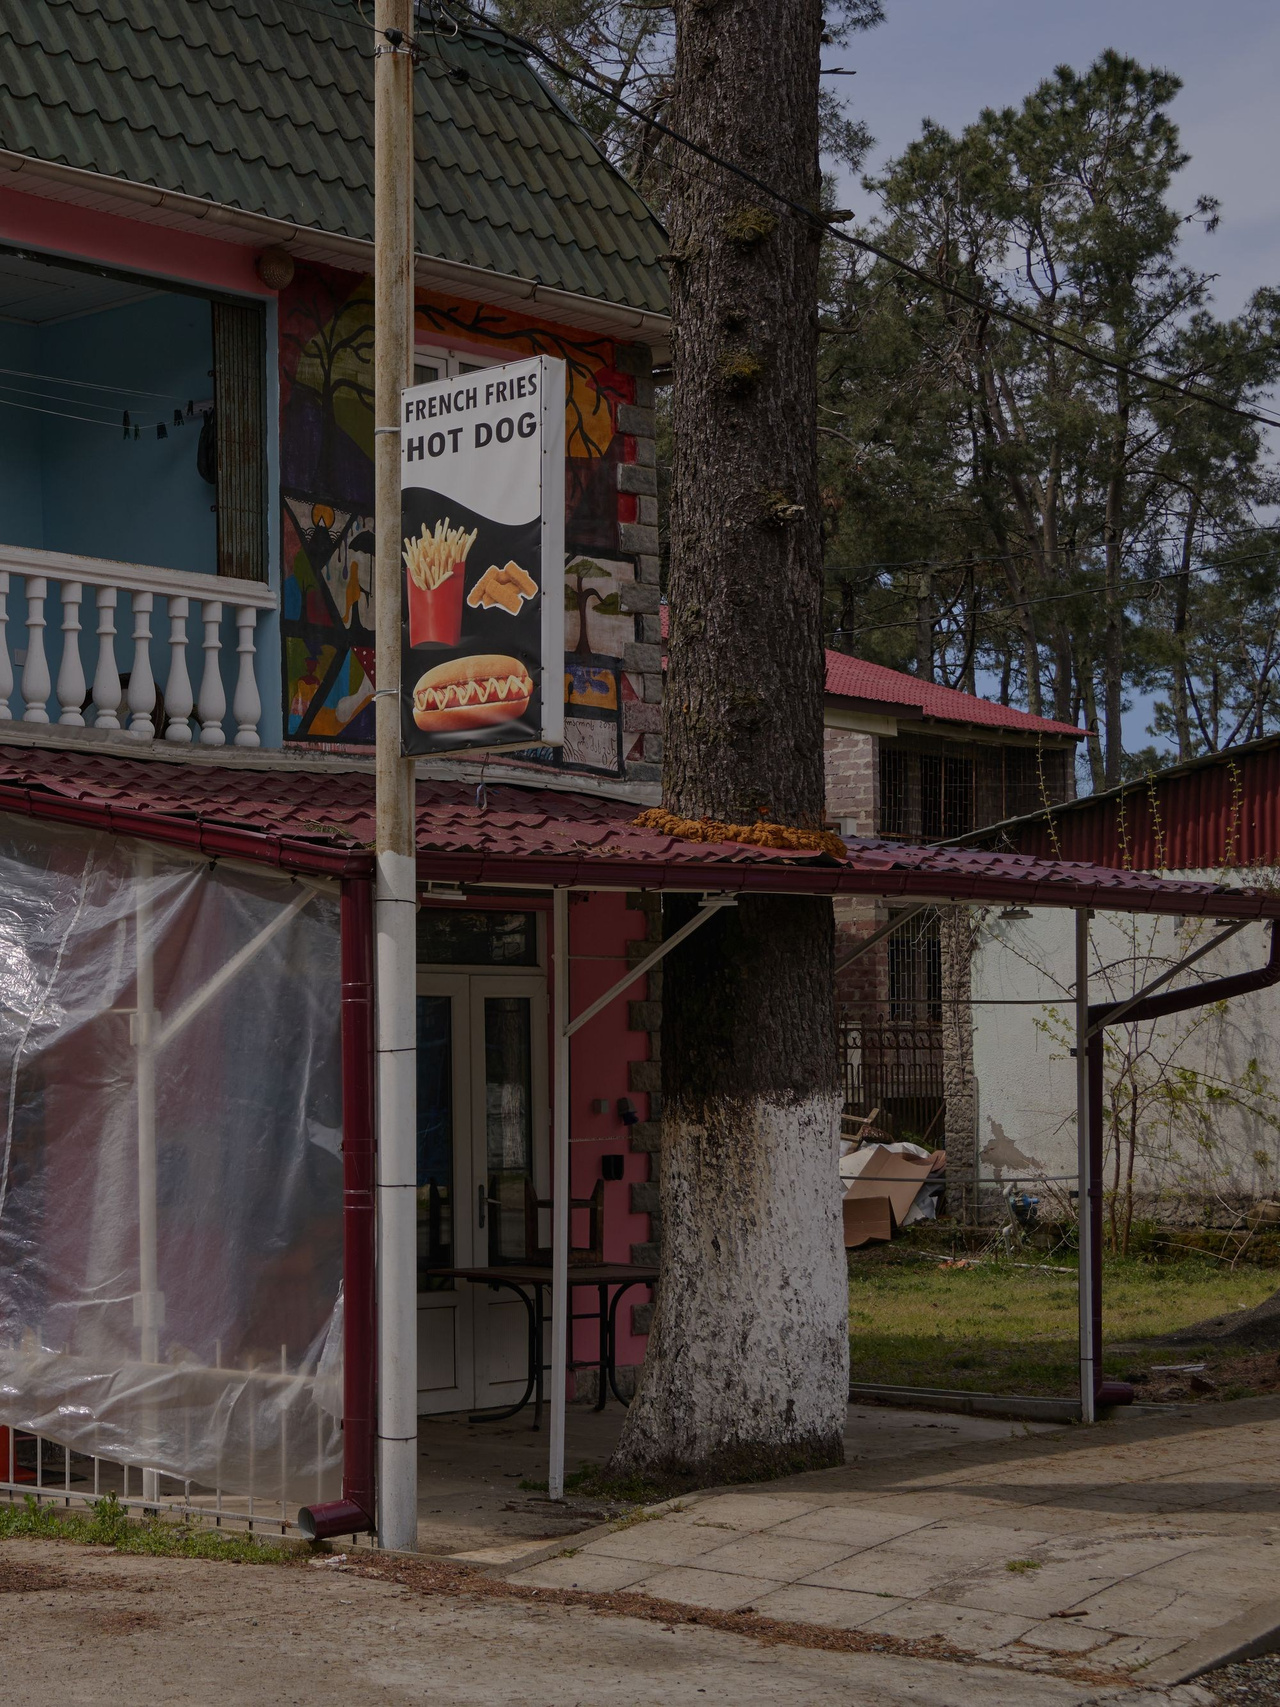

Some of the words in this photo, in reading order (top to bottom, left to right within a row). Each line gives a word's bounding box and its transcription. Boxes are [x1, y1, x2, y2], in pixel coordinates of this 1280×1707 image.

[405, 387, 477, 423] FRENCH
[485, 373, 537, 406] FRIES
[407, 427, 463, 462] HOT
[475, 412, 537, 448] DOG
